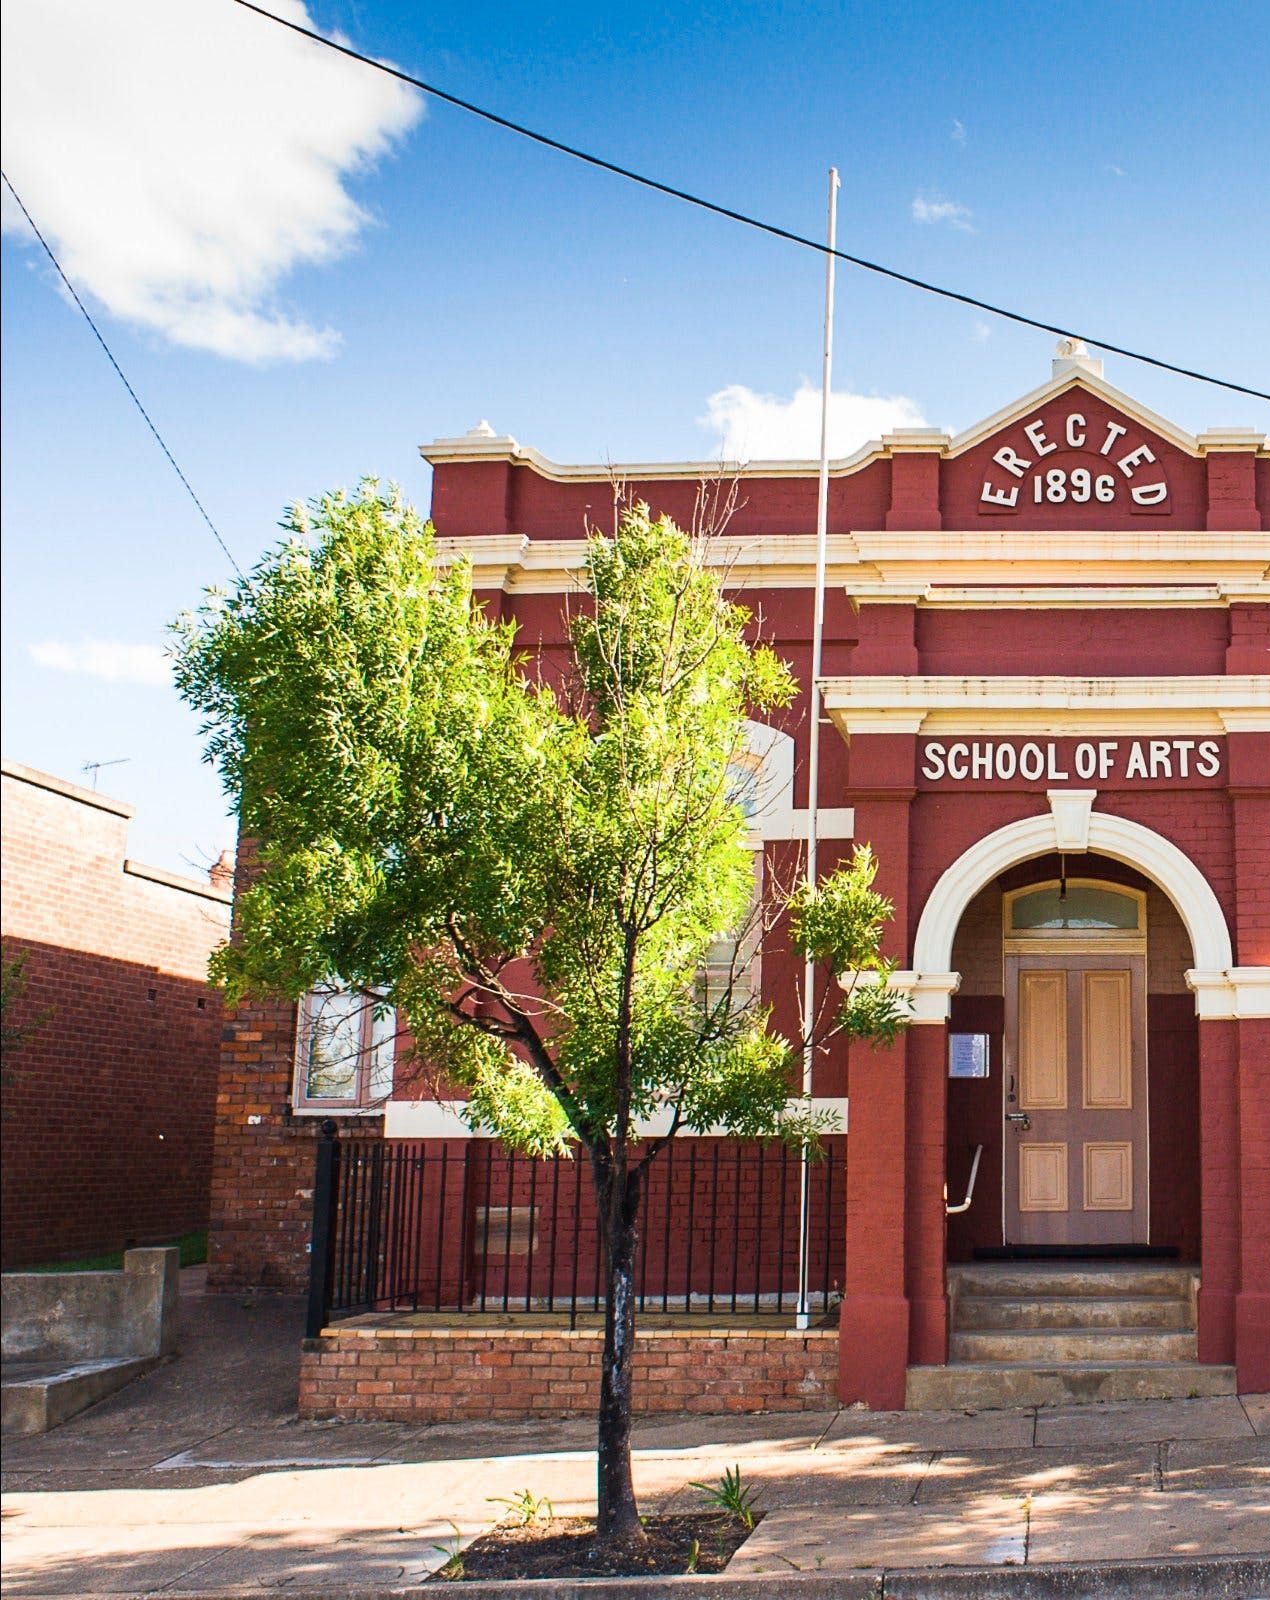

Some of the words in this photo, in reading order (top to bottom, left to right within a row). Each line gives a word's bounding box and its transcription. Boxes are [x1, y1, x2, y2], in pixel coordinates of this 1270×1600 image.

[980, 413, 1168, 507] ERECTED
[1033, 468, 1115, 504] 1896
[921, 742, 1068, 780] SCHOOL
[1075, 742, 1118, 779] OF
[1126, 740, 1220, 779] ARTS
